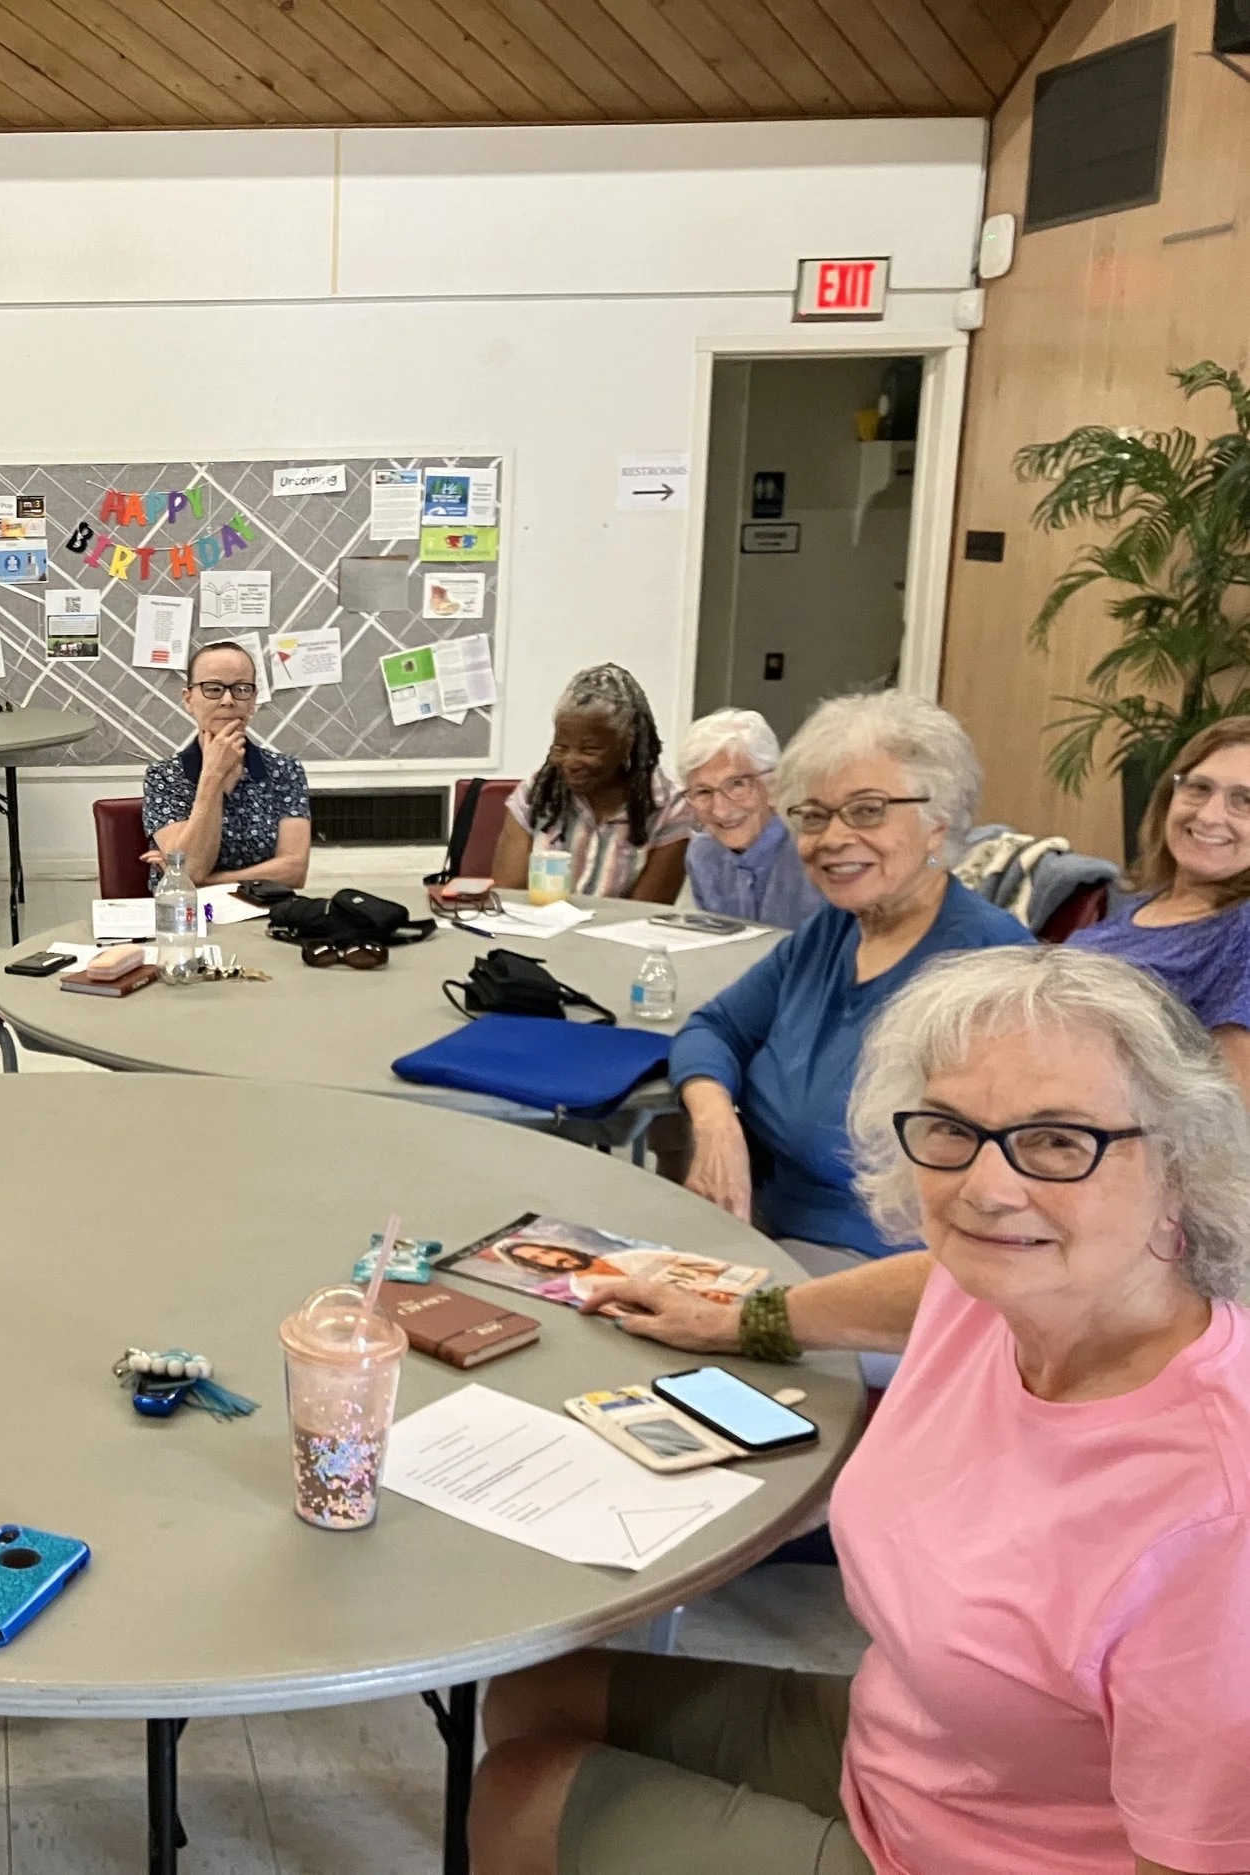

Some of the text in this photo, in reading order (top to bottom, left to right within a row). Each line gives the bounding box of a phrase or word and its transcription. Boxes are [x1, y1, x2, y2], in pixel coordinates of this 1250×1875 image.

[817, 263, 875, 307] EXIT
[100, 486, 204, 526] HAPPY
[66, 511, 255, 580] BIRTHDAY
